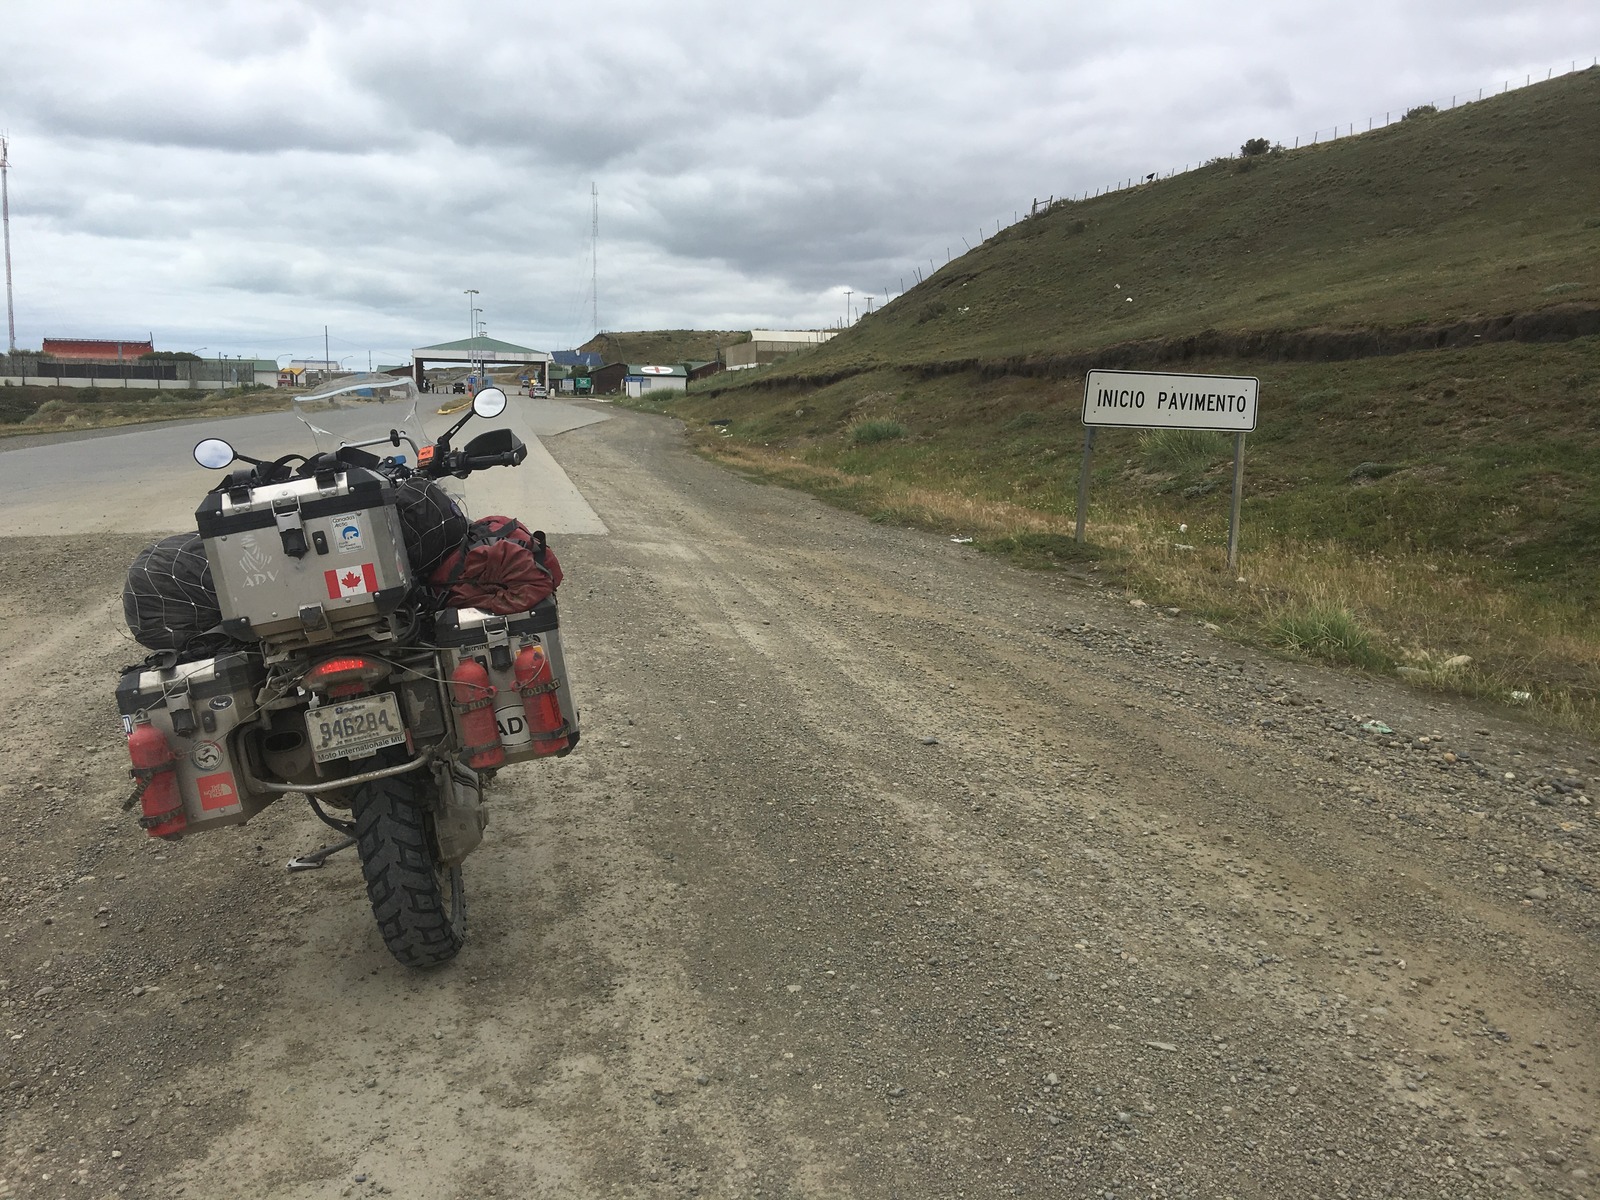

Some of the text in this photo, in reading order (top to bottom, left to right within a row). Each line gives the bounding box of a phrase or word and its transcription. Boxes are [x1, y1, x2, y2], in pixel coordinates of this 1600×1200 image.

[1097, 389, 1247, 412] INICIO PAVIMENTO
[242, 570, 279, 588] ADV
[320, 709, 390, 741] 946284
[317, 752, 337, 761] Moto
[338, 737, 390, 757] Internationale
